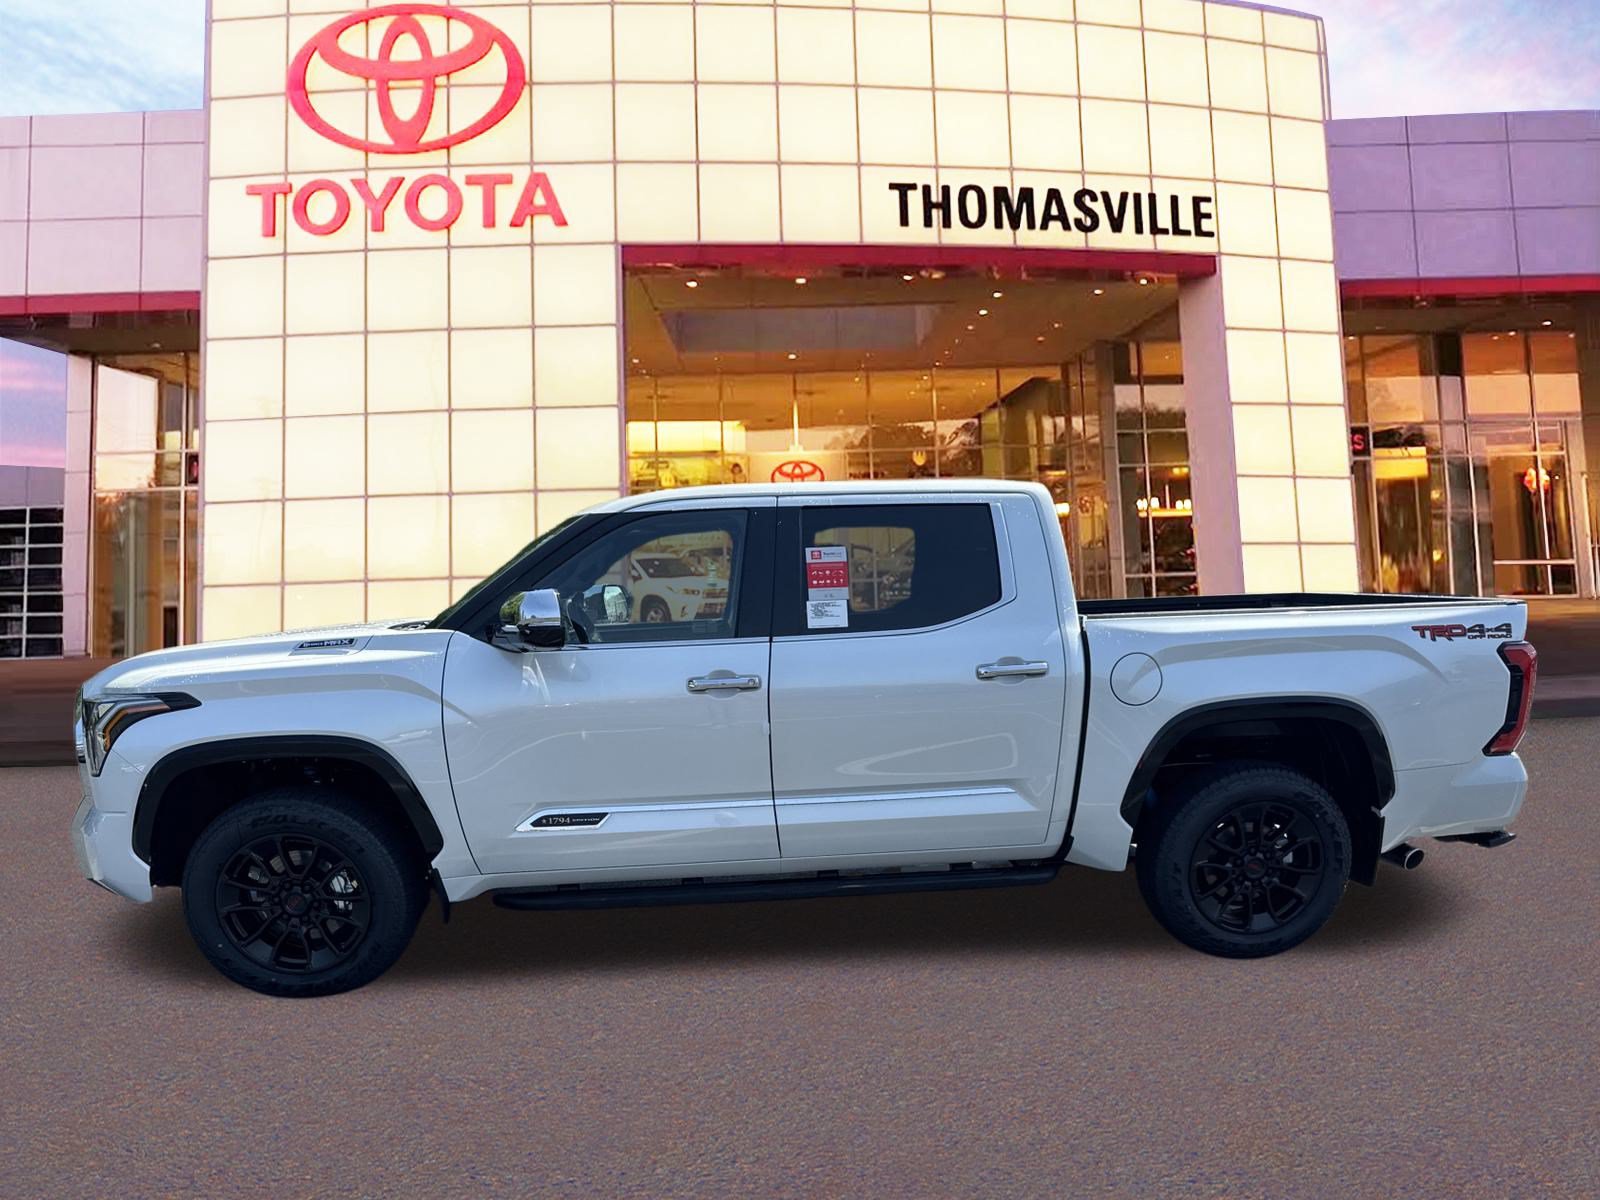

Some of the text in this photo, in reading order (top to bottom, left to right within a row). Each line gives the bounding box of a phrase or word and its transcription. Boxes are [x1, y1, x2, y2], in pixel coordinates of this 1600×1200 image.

[246, 172, 569, 238] TOYOTA
[888, 182, 1215, 238] THOMASVILLE
[1411, 624, 1467, 641] TRD
[548, 816, 570, 825] 1794
